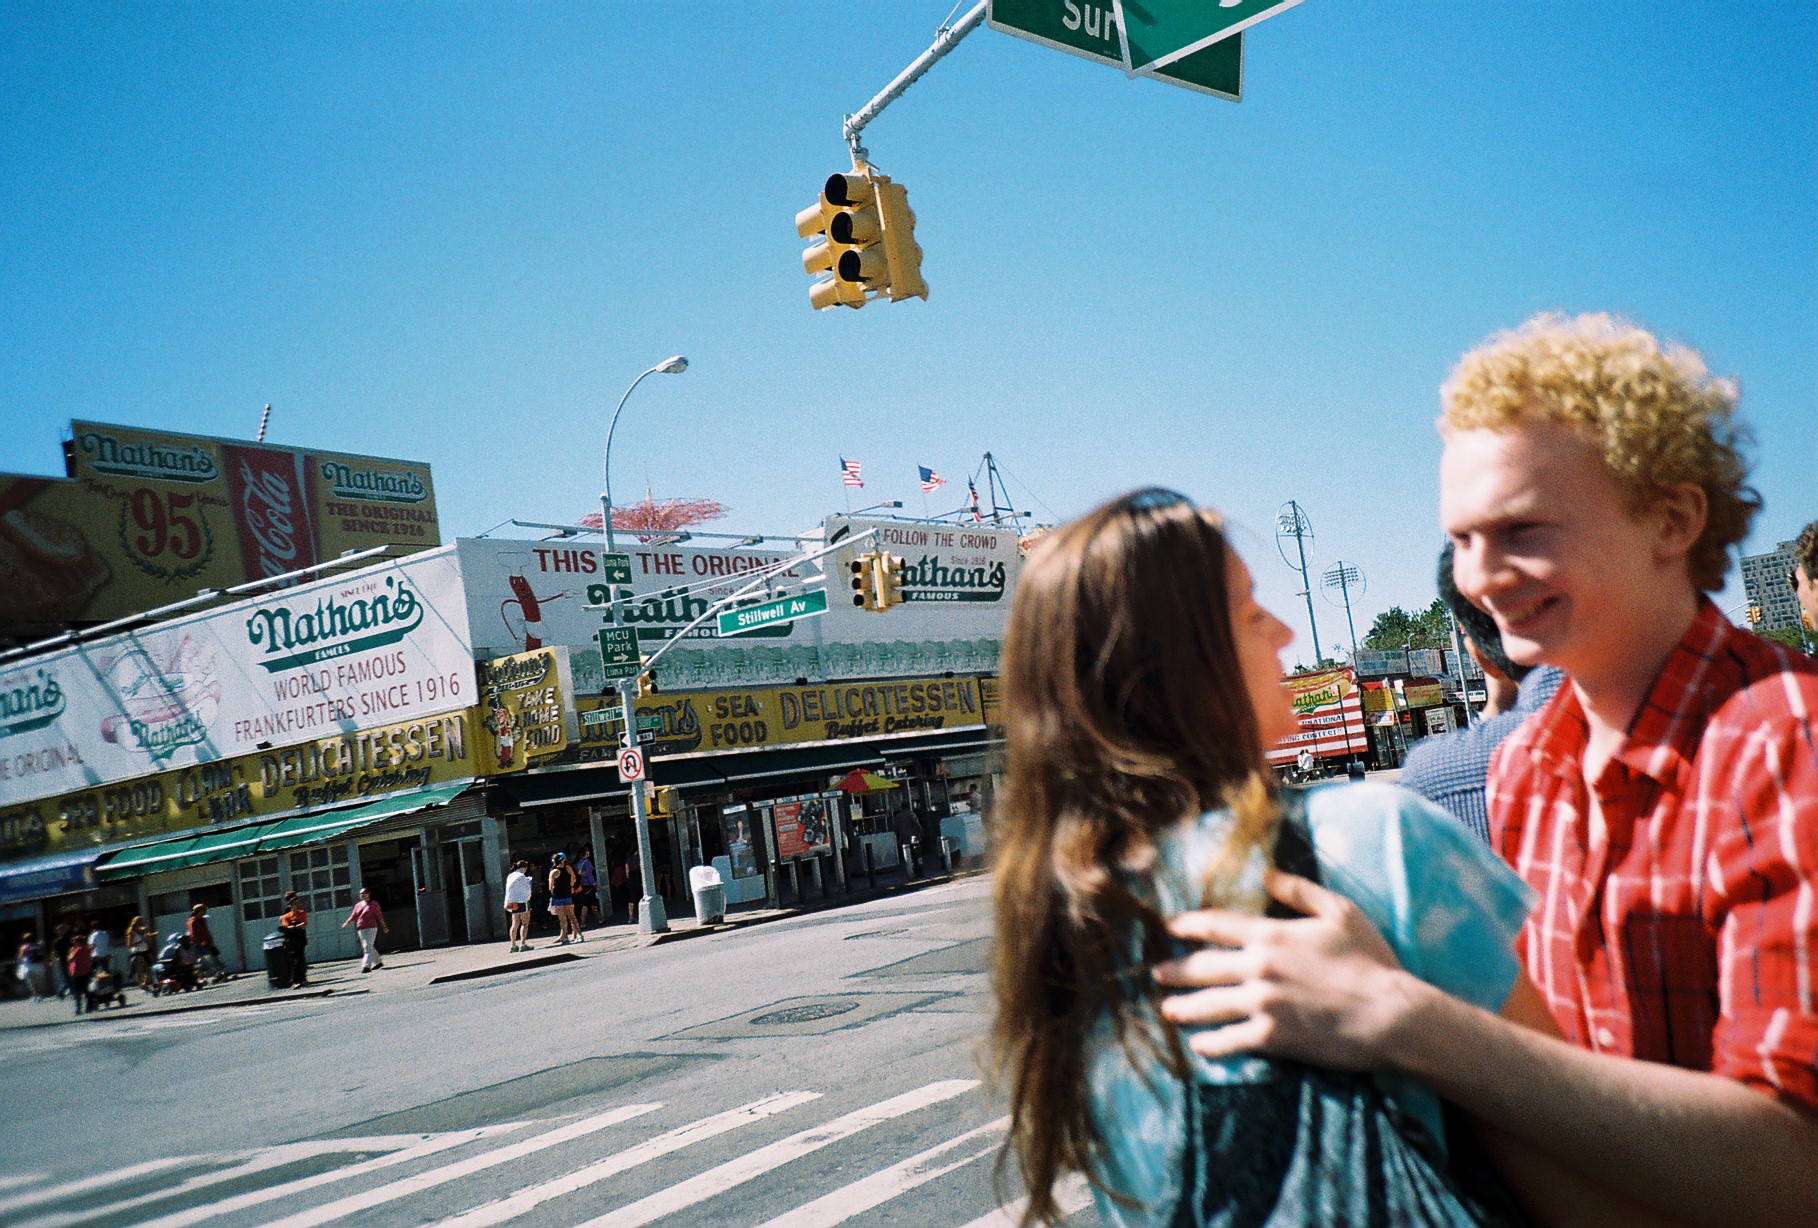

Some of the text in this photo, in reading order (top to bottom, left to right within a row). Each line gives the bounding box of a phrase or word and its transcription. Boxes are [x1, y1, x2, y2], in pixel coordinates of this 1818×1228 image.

[81, 433, 214, 473] Nathan's
[321, 462, 424, 495] Nathan's
[130, 487, 200, 559] 95
[326, 502, 436, 523] THE ORIGINAL
[341, 519, 390, 534] SINCE
[883, 529, 997, 550] FOLLOW THE CROWD
[532, 549, 597, 574] THIS
[635, 552, 686, 576] THE
[901, 554, 1006, 588] athan's
[911, 592, 960, 600] FAMOUS
[246, 576, 416, 654] Nathan's
[738, 600, 806, 627] Stillwell Av
[606, 630, 629, 641] MCU
[607, 641, 632, 653] Park
[274, 651, 407, 702] WORLD FAMOUS
[233, 696, 356, 743] FRANKFURTERS
[362, 684, 410, 716] SINCE
[416, 672, 461, 702] 1916
[517, 687, 555, 709] TAKE
[711, 695, 759, 719] SEA
[780, 681, 976, 730] DELICATESSEN
[1293, 687, 1334, 708] athan'
[522, 705, 559, 727] HOME
[584, 708, 616, 725] Stillwell
[825, 714, 945, 740] Buffet Catering
[523, 724, 561, 751] FOOD
[711, 721, 768, 746] FOOD
[260, 715, 465, 798] DELICATESSEN
[356, 764, 432, 797] Catering
[103, 780, 163, 823] FOOD
